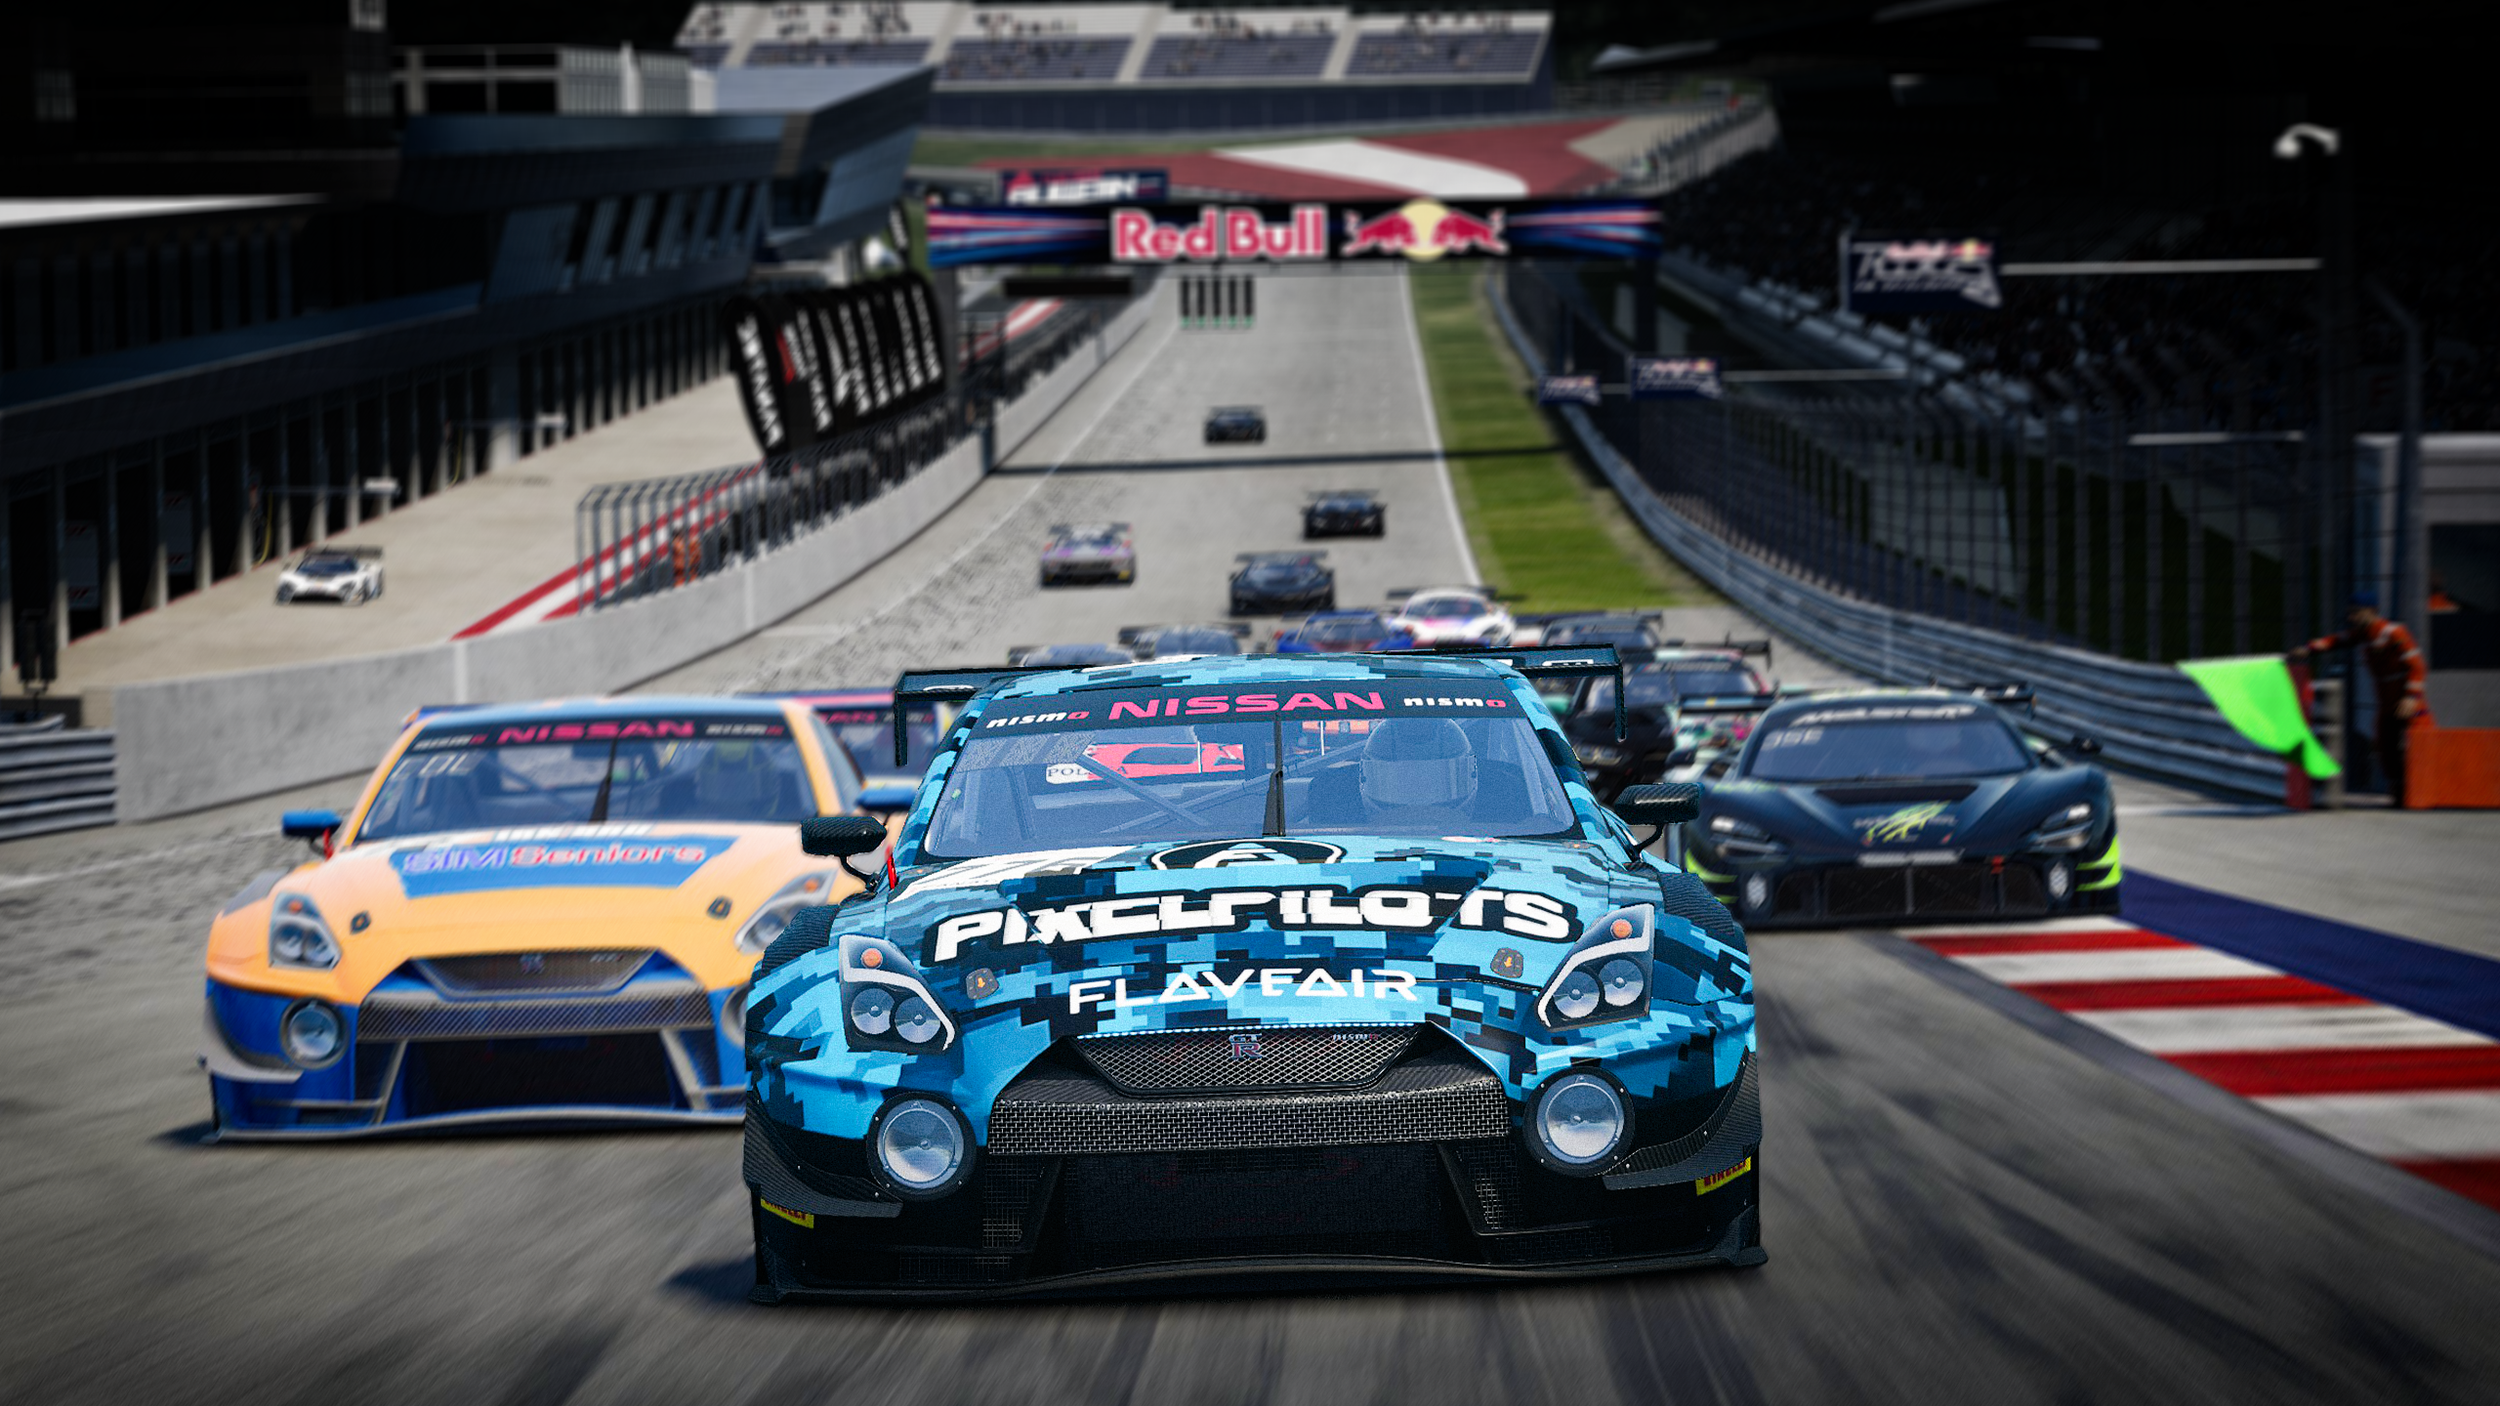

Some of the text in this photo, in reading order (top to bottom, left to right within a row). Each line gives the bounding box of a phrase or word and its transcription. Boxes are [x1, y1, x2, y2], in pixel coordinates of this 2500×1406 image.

[1112, 207, 1326, 261] Red Bull
[986, 692, 1507, 728] nismo NISSAN nismo
[497, 721, 696, 745] NISSAN
